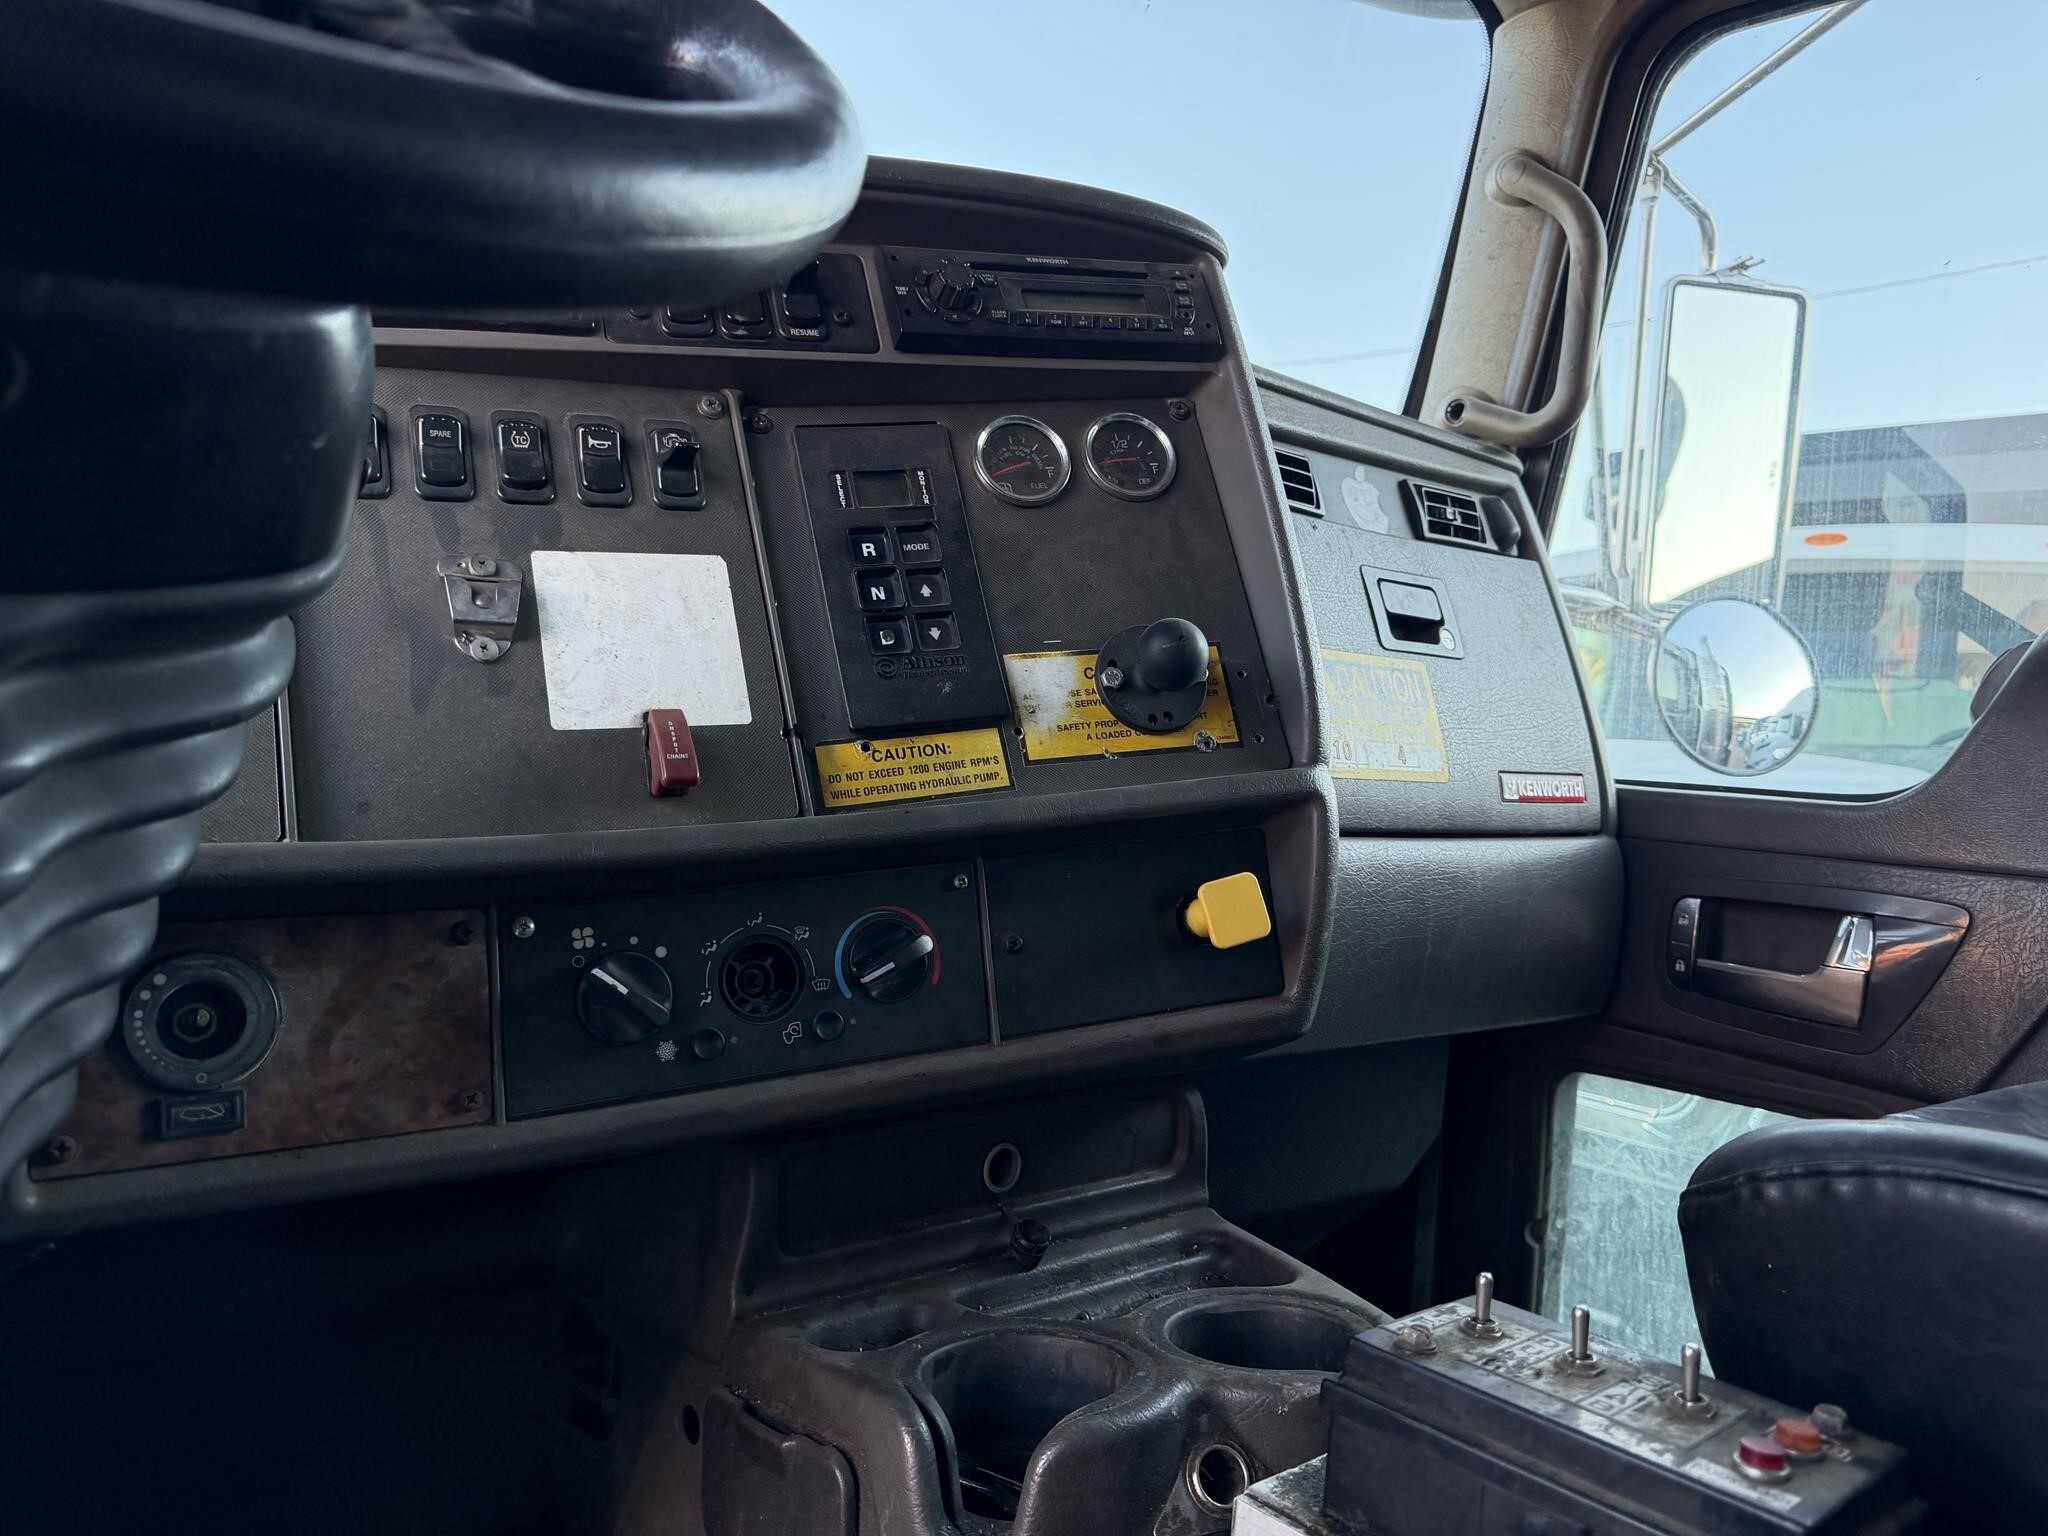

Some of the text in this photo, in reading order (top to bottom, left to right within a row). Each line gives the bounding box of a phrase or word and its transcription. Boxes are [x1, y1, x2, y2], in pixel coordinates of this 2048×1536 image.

[1026, 257, 1069, 265] KENWORTH
[789, 328, 820, 337] RESUME
[429, 429, 452, 438] SPARE
[514, 435, 528, 445] TC
[835, 473, 846, 508] SELECT
[917, 470, 930, 504] MONITOR
[861, 543, 876, 557] R
[902, 542, 930, 551] MODE
[870, 586, 886, 600] N
[902, 655, 966, 672] Allison
[1056, 719, 1119, 732] SAFETY PROP
[1086, 732, 1093, 741] A
[1096, 729, 1132, 740] LOADED
[871, 742, 952, 763] CAUTION:
[1333, 740, 1352, 760] 10
[828, 755, 1000, 784] DO NOT EXCEED 1200 ENGINE RPM'S
[830, 771, 1004, 801] WHILE OPERATING HYDRAULIC PUMP.
[1518, 780, 1584, 798] KENWORTH
